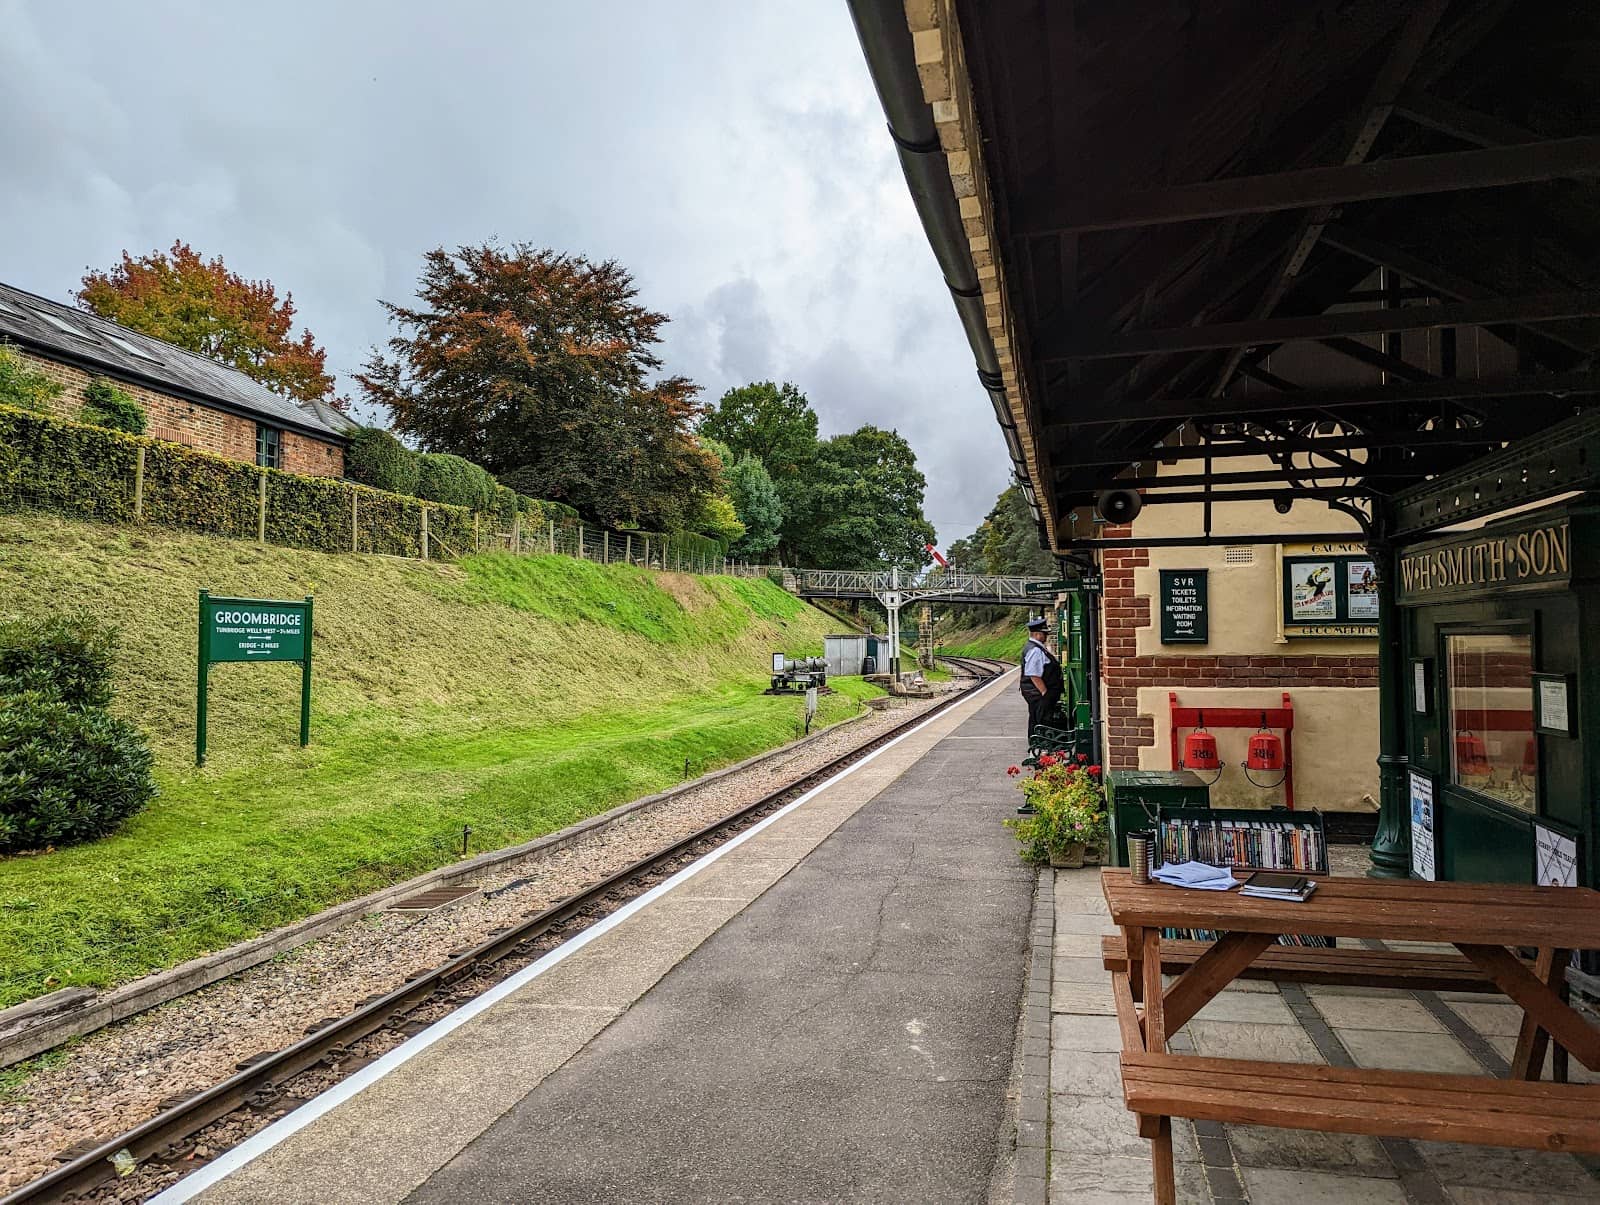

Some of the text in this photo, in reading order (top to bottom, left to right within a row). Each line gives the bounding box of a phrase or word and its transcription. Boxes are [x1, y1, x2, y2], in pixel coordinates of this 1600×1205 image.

[215, 611, 301, 626] GROOMBRIDGE
[216, 626, 245, 634] TUNBRIDGE
[1302, 626, 1380, 635] GROOMBRIDG
[1192, 749, 1214, 759] FIRE
[1253, 748, 1275, 759] FIRE
